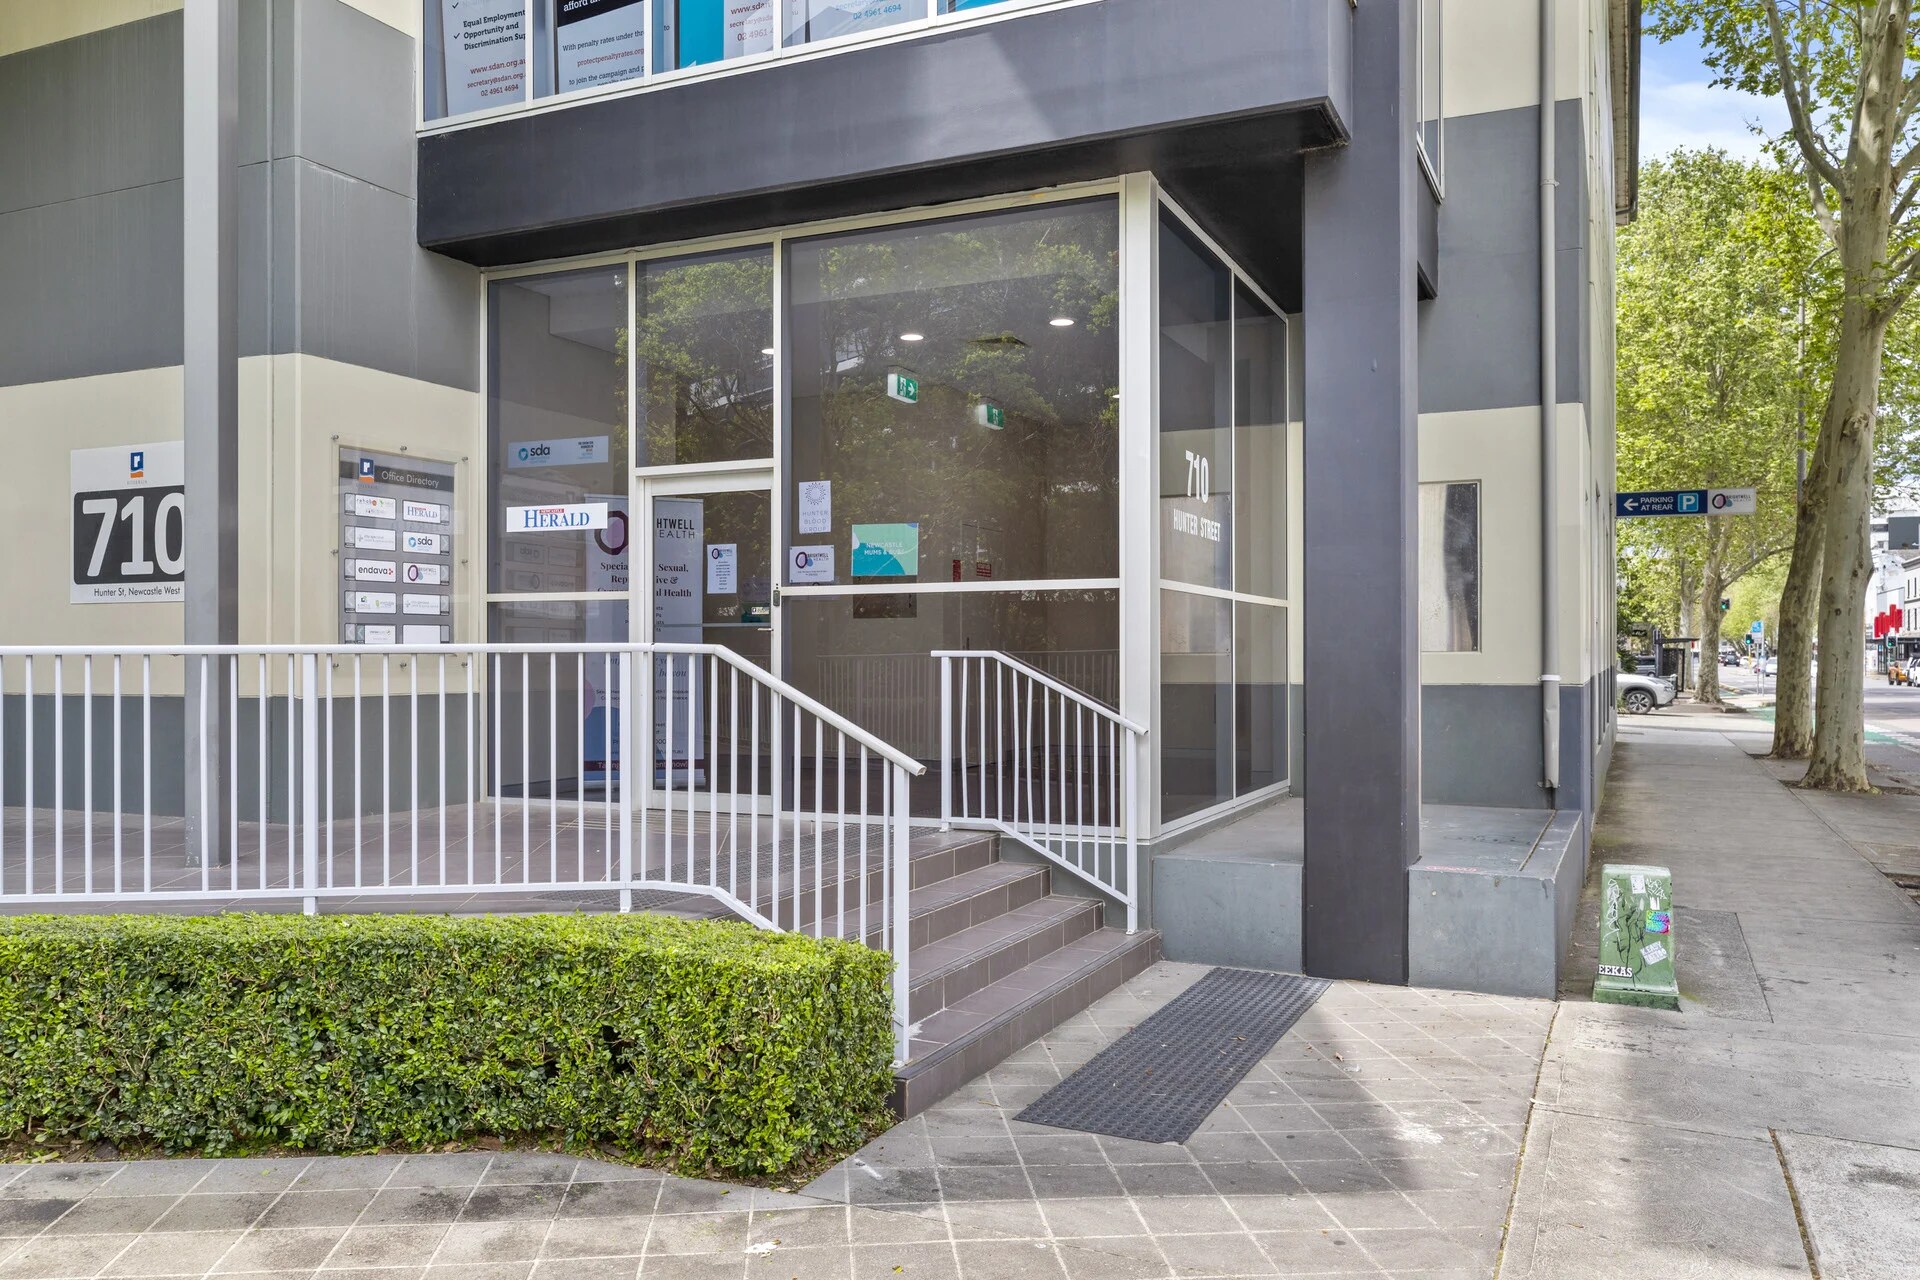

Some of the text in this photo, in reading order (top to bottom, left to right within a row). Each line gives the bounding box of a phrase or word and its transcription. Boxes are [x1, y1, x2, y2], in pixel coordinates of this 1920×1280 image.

[463, 10, 525, 28] Equal Employment
[853, 12, 862, 20] 02
[463, 22, 519, 39] Opportunity and
[464, 35, 514, 50] Discrimination
[578, 40, 599, 50] penalty
[600, 36, 615, 44] rates
[616, 32, 633, 40] under
[634, 29, 644, 37] thr
[577, 48, 644, 67] protectpenaltyrates.org
[576, 77, 587, 85] join
[599, 69, 627, 81] campaign
[489, 87, 503, 95] 4961
[504, 84, 519, 92] 4694
[530, 444, 550, 456] sda
[382, 471, 439, 488] Office Directory
[1186, 450, 1209, 503] 710
[1640, 496, 1674, 504] PARKING
[1683, 496, 1696, 510] P
[407, 506, 438, 518] HERALD
[524, 509, 590, 528] HERALD
[656, 518, 694, 530] HTWELL
[1174, 508, 1220, 542] HUNTER STREET
[82, 492, 184, 577] 710
[418, 536, 432, 546] sda
[660, 530, 695, 539] EALTH
[358, 566, 388, 575] endava
[601, 562, 688, 573] Specia Sexual,
[94, 586, 181, 597] Hunter St, Newcastle West
[664, 589, 692, 597] Health
[1599, 964, 1632, 978] EEKAS
